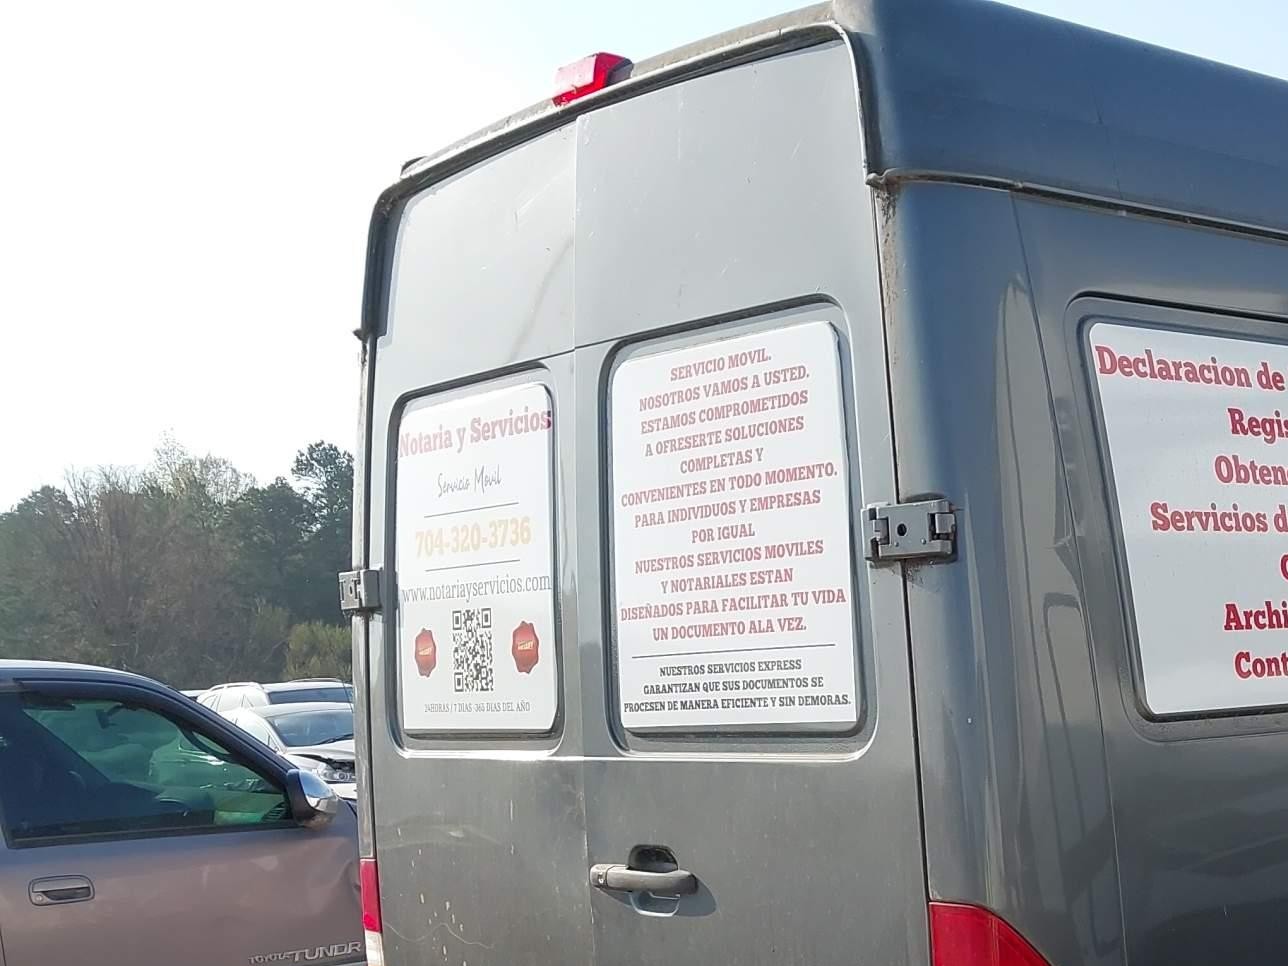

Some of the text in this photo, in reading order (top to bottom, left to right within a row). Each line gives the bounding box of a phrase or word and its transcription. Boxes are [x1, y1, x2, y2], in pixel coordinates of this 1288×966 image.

[670, 349, 771, 382] SERVICIO MOVIL.
[1095, 345, 1252, 389] Declaracion
[1257, 362, 1285, 391] de
[639, 365, 809, 412] NOSOTROS VAMOS A USTED.
[641, 390, 809, 434] ESTAMOS COMPROMETIDOS
[399, 407, 552, 458] Notaria y Servicios
[645, 416, 804, 457] A OFRESERTE SOLUCIONES
[680, 448, 764, 474] COMPLETAS Y
[437, 464, 502, 498] Servicio Movil
[621, 463, 838, 507] CONVENIENTES EN TODO MOMENTO.
[635, 490, 821, 528] PARA INDIVIDUOS Y EMPRESAS
[1150, 502, 1269, 535] Servicios
[415, 516, 531, 558] 704-320-3736
[692, 524, 755, 543] POR IGUAL
[635, 541, 823, 574] NUESTROS SERVICIOS MOVILES
[402, 573, 551, 604] www.notariayservicios.com
[661, 568, 793, 593] Y NOTARIALES ESTAN
[621, 588, 846, 621] DISEÑADOS PARA FACILITAR TU VIDA
[653, 616, 807, 642] UN DOCUMENTO ALA VEZ.
[660, 659, 802, 677] NUESTROS SERVICIOS EXPRESS
[643, 676, 823, 695] GARANTIZAN QUE SUS DOCUMENTOS SE
[624, 693, 851, 713] PROCESEN DE MANERA EFICIENTE Y SIN DEMORAS.
